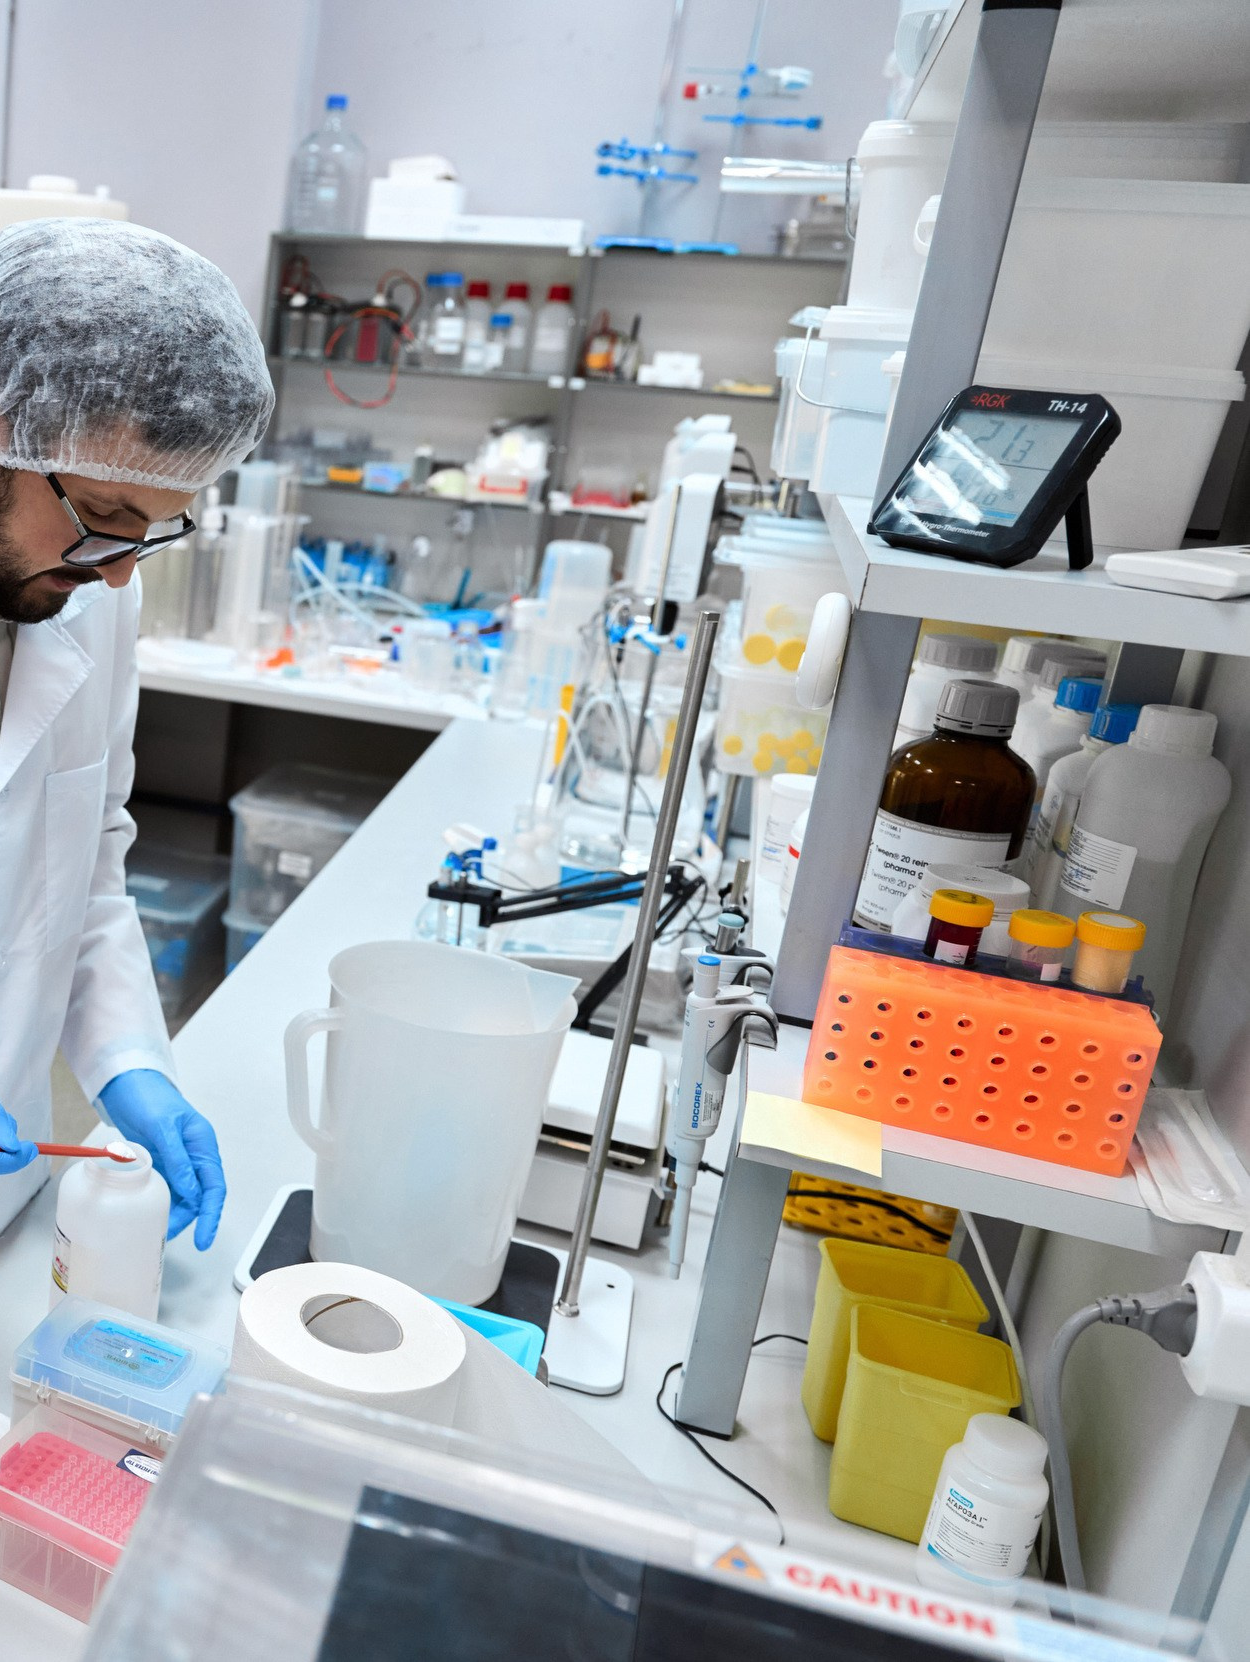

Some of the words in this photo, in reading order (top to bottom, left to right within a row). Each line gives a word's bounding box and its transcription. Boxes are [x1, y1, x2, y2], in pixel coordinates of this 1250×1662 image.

[976, 393, 1011, 408] RGK
[1048, 400, 1088, 414] TH-14
[900, 855, 911, 864] 20
[883, 860, 916, 877] (pharma
[897, 879, 907, 888] 20
[691, 1082, 703, 1129] SOCOREX
[134, 1463, 151, 1474] FILTER
[786, 1563, 996, 1639] CAUTION
